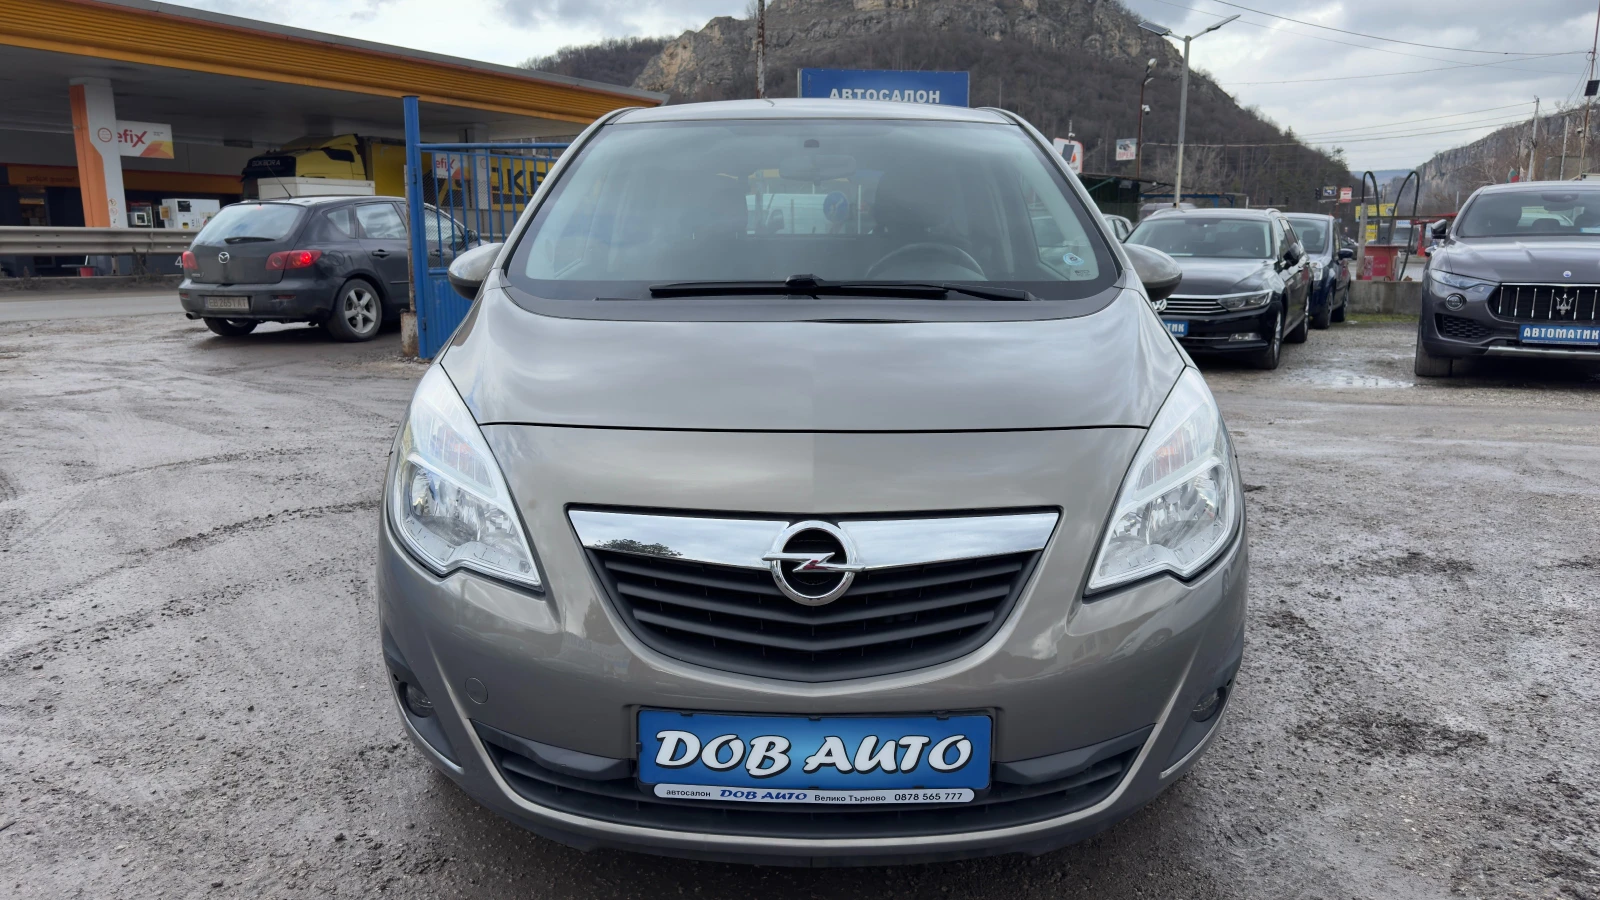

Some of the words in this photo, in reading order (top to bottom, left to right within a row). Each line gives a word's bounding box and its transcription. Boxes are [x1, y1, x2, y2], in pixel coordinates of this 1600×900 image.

[829, 88, 941, 104] АВТОСАЛОН
[117, 128, 148, 148] efix
[1117, 151, 1135, 159] OPEN
[1523, 327, 1600, 340] АВТОМАТИК
[654, 729, 792, 779] DOB
[802, 734, 974, 774] AUTO
[665, 789, 711, 798] автосалон
[719, 789, 758, 801] DOB
[760, 791, 808, 801] AUTO
[814, 793, 847, 803] Велико
[848, 794, 887, 803] Търново
[894, 793, 921, 802] 0878
[922, 792, 941, 801] 565
[943, 791, 963, 801] 777
